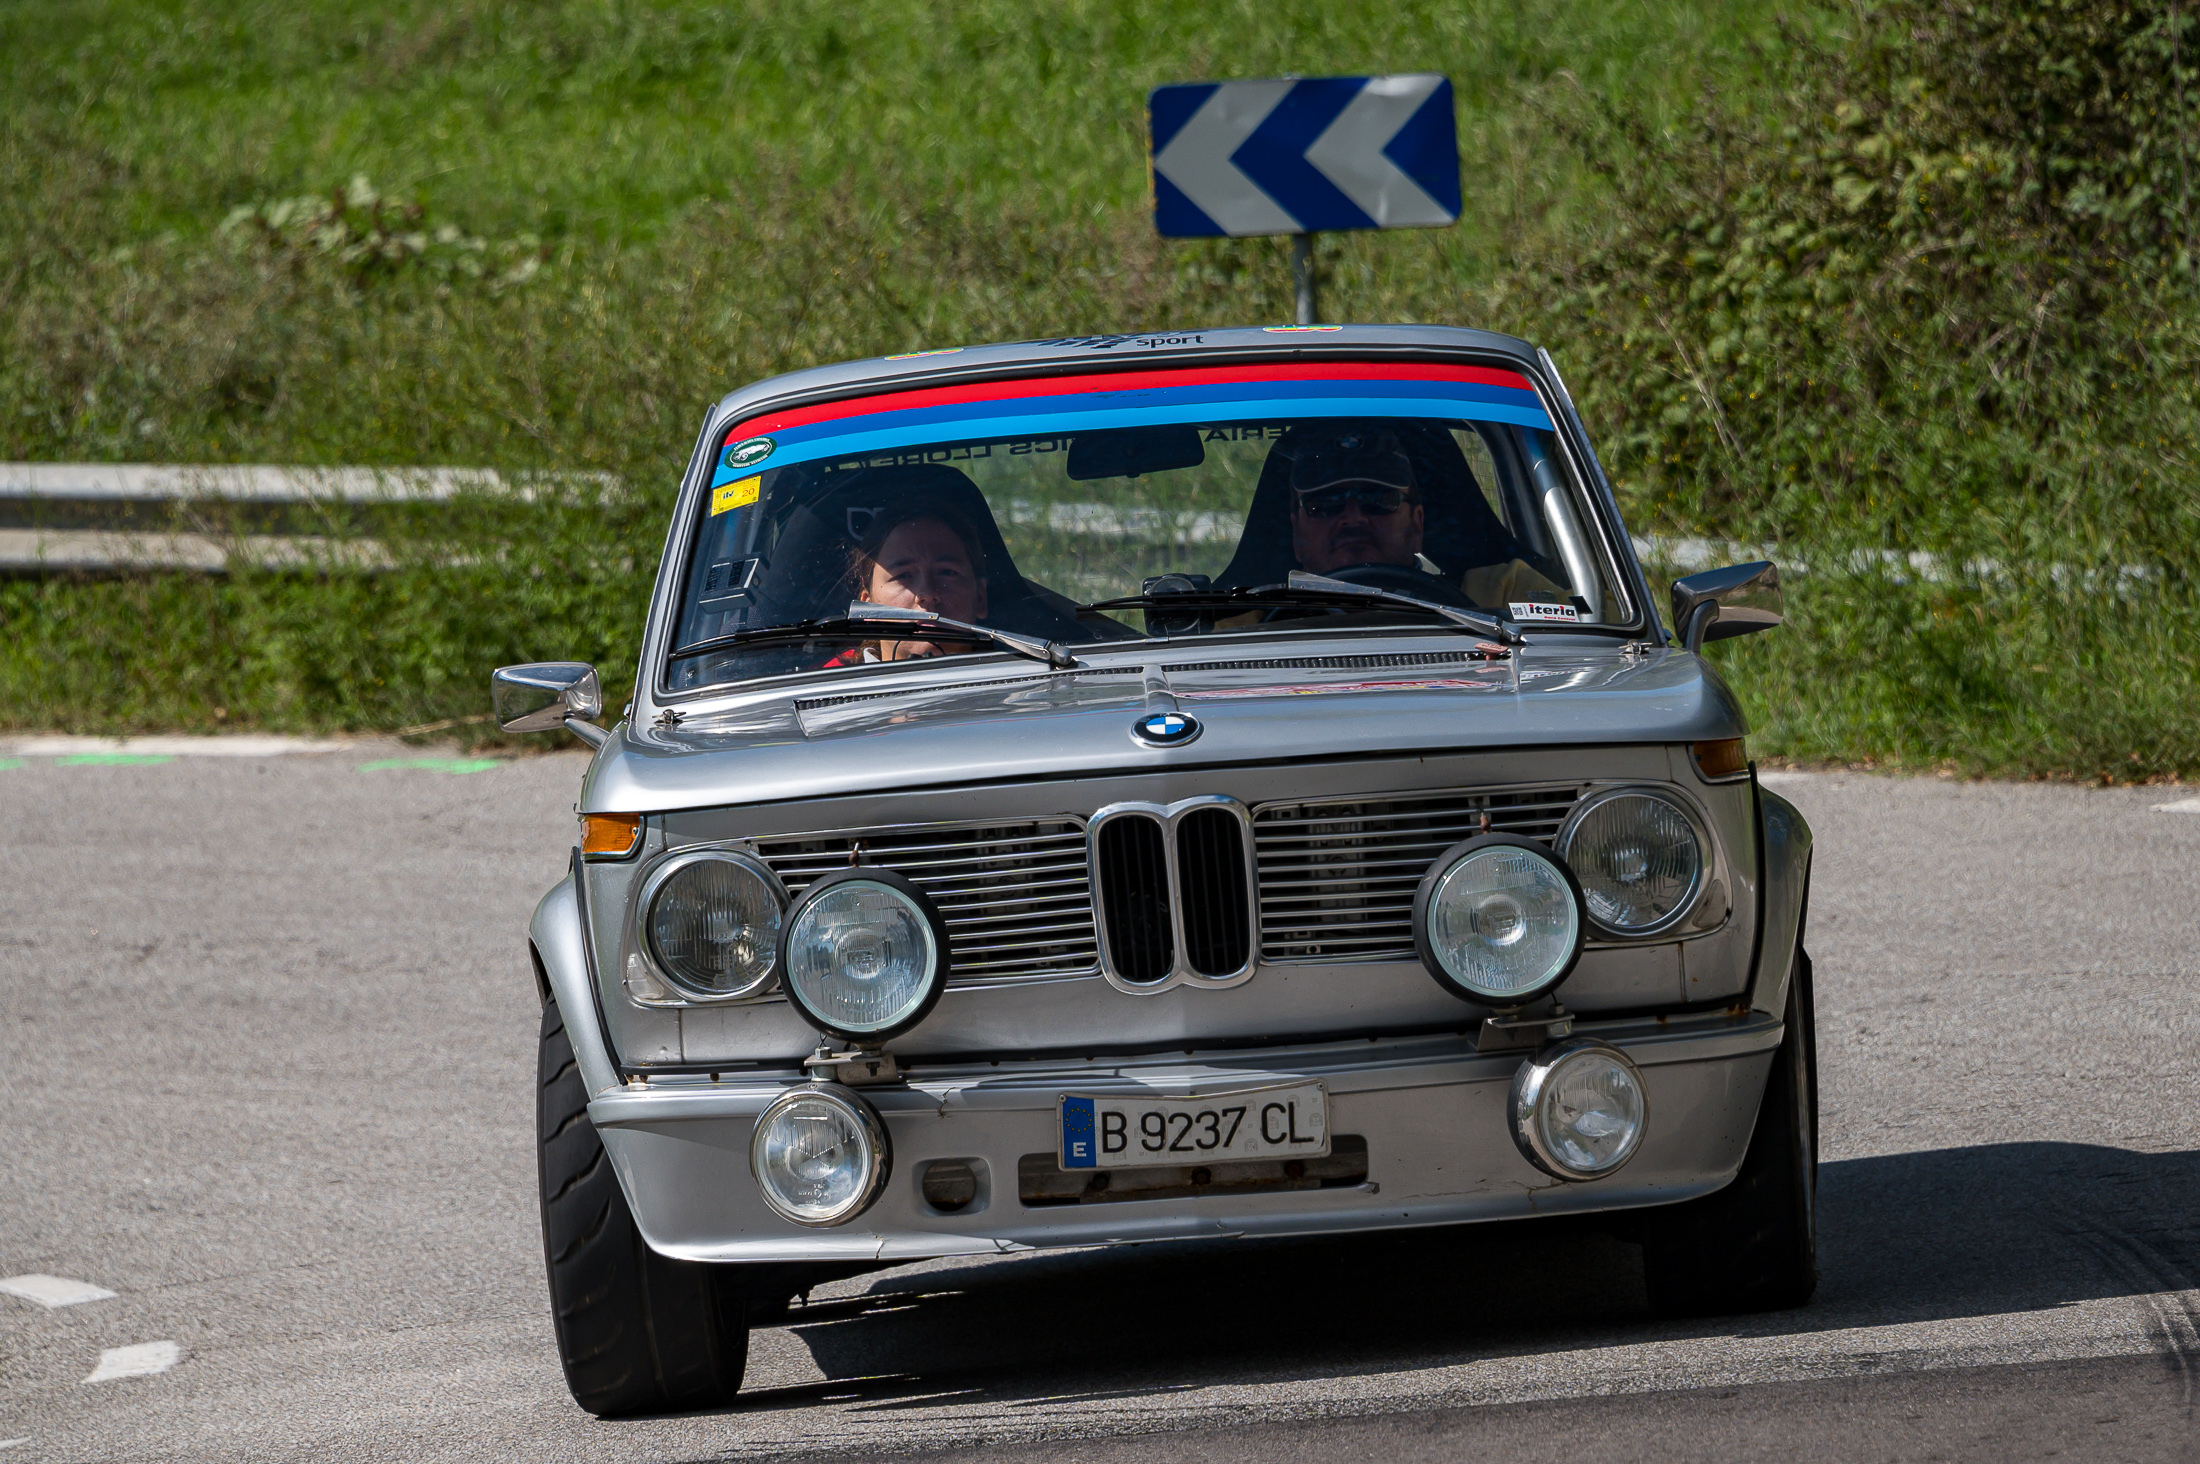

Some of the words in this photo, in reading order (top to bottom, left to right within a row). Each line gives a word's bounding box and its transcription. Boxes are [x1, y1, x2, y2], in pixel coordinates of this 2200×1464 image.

[1136, 335, 1204, 348] sport
[741, 487, 755, 498] 20
[1528, 603, 1575, 616] iteria
[1101, 1111, 1128, 1153] B
[1140, 1105, 1247, 1153] 9237
[1261, 1101, 1315, 1145] CL
[1073, 1141, 1087, 1157] E
